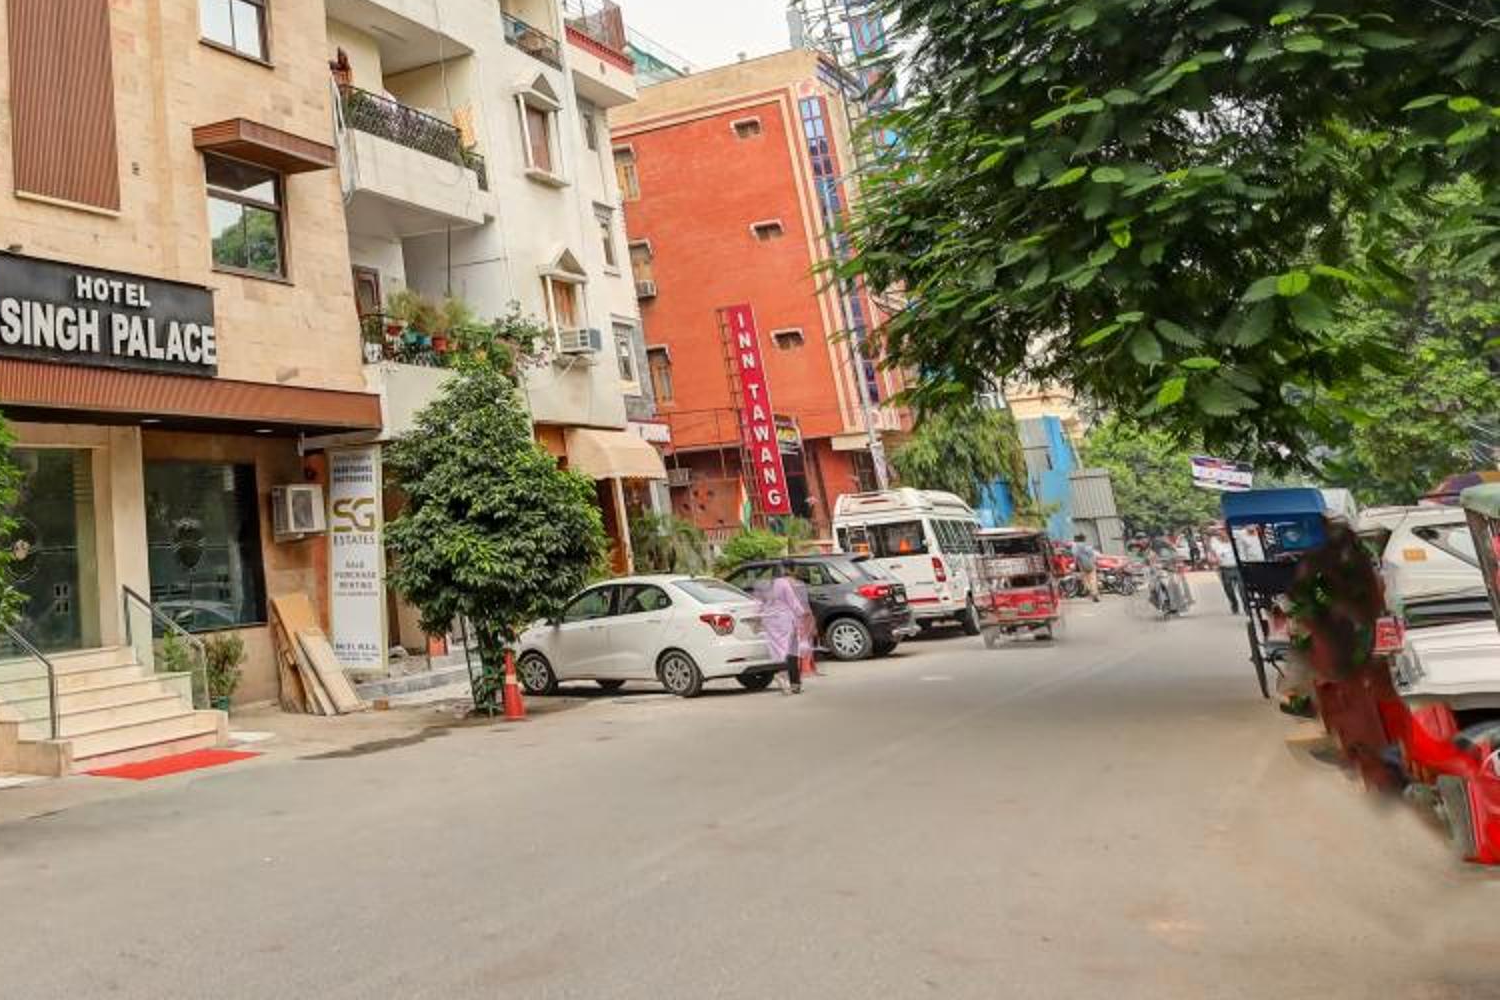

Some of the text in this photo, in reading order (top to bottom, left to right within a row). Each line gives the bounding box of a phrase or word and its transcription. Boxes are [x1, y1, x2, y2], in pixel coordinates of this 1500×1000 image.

[75, 275, 151, 308] HOTEL
[0, 296, 217, 365] SINGH PALACE
[736, 312, 782, 506] INN TAWANG
[333, 497, 375, 532] SG
[333, 535, 375, 545] ESTATES
